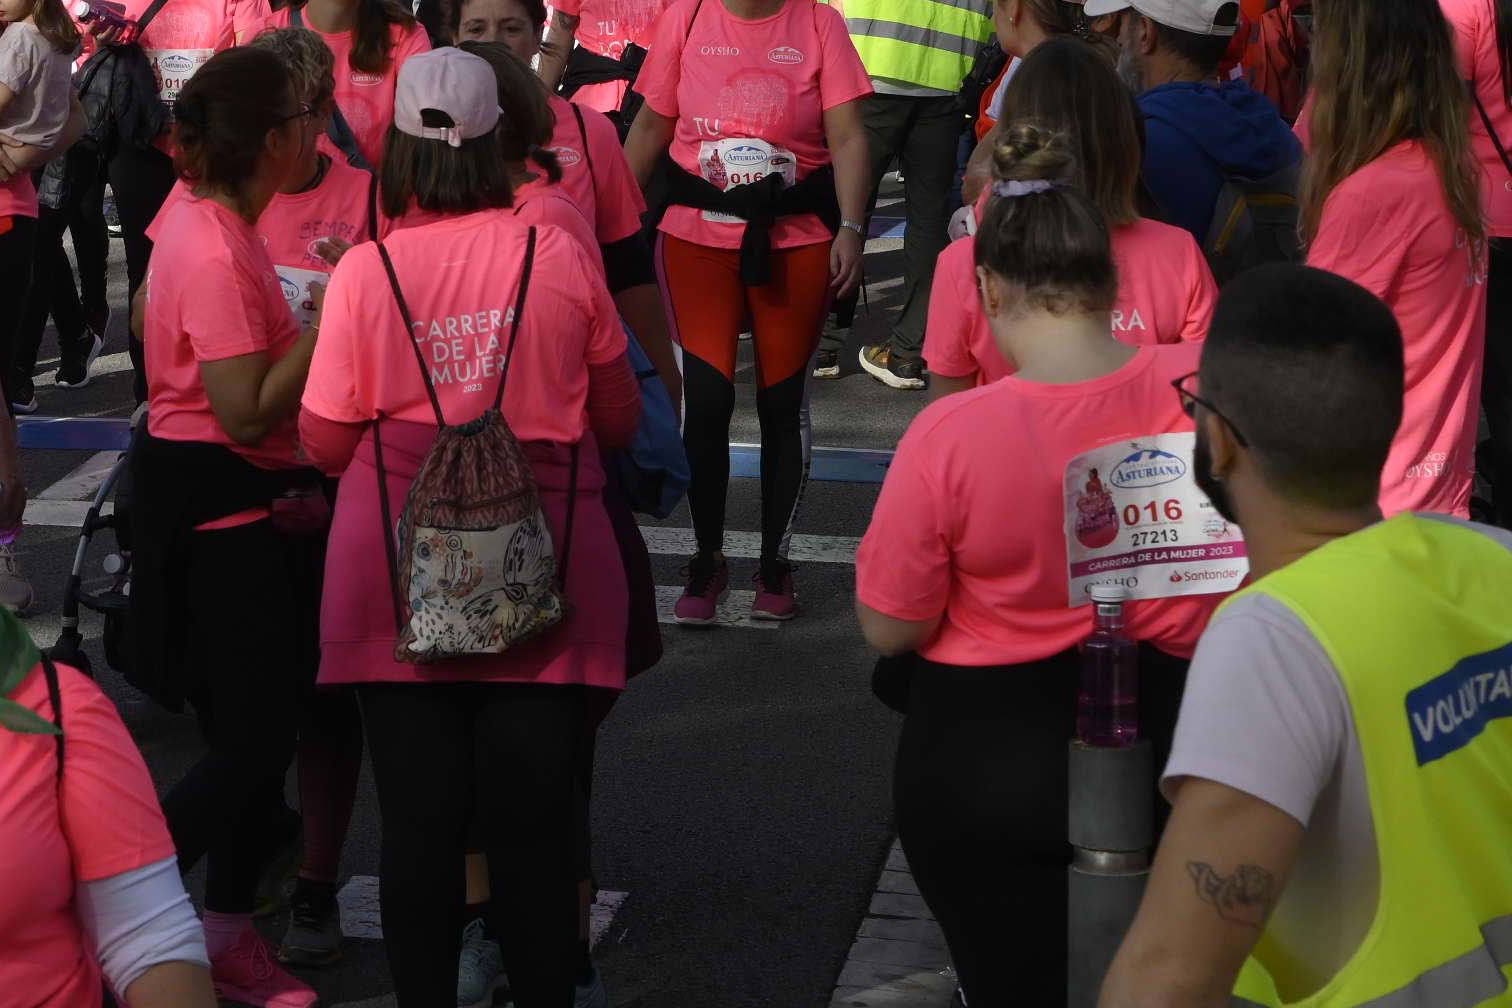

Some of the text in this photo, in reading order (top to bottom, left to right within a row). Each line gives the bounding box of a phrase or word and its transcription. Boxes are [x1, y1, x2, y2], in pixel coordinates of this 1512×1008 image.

[701, 46, 740, 57] OYSHO
[693, 117, 720, 136] TU
[730, 171, 764, 185] 016
[411, 305, 516, 344] CARRERA
[432, 332, 502, 363] DE LA
[431, 354, 507, 386] MUJER
[463, 383, 483, 393] 2023
[1116, 464, 1182, 485] ASTURIANA
[1123, 498, 1183, 526] 016
[1131, 528, 1179, 547] 27213
[1089, 545, 1234, 572] CARRERA DE LA MUJER 2023
[1184, 567, 1239, 583] Santander
